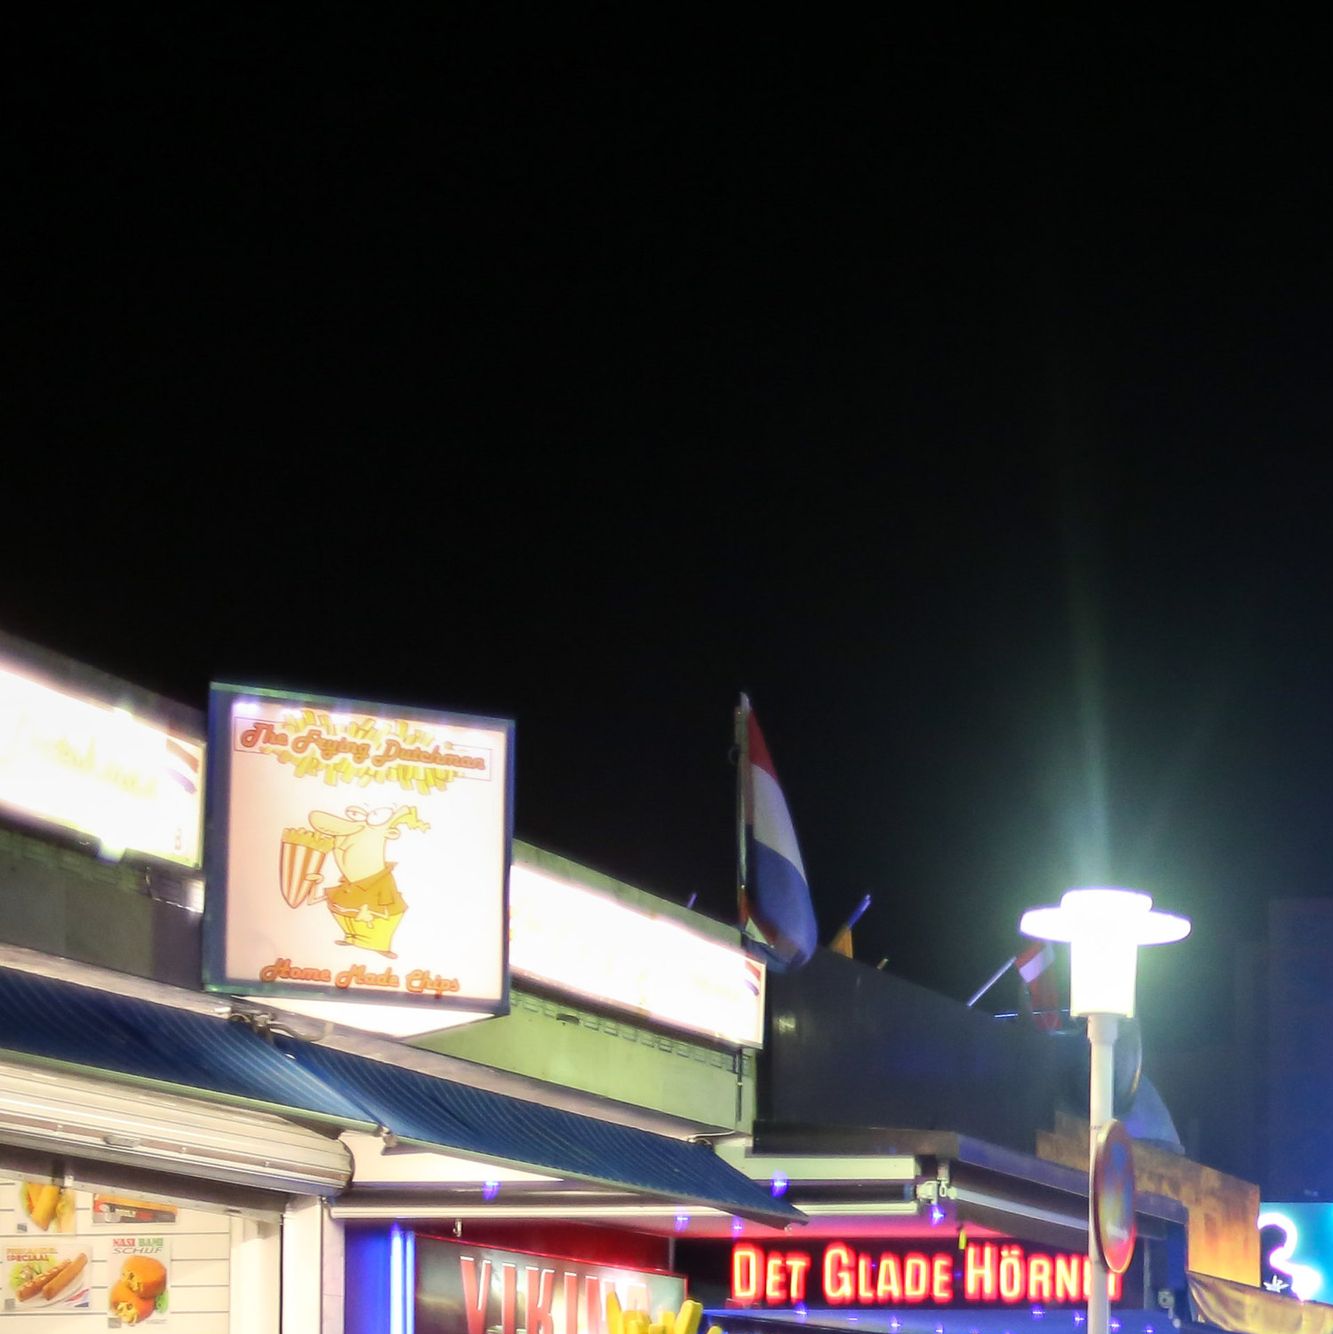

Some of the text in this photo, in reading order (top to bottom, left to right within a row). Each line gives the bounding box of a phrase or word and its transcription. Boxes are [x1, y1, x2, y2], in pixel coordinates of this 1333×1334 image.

[241, 722, 486, 770] The Frying Dutchman
[259, 957, 460, 999] Home Made Chips
[113, 1237, 136, 1247] NASI
[733, 1246, 810, 1300] DET
[823, 1245, 953, 1300] GLADE
